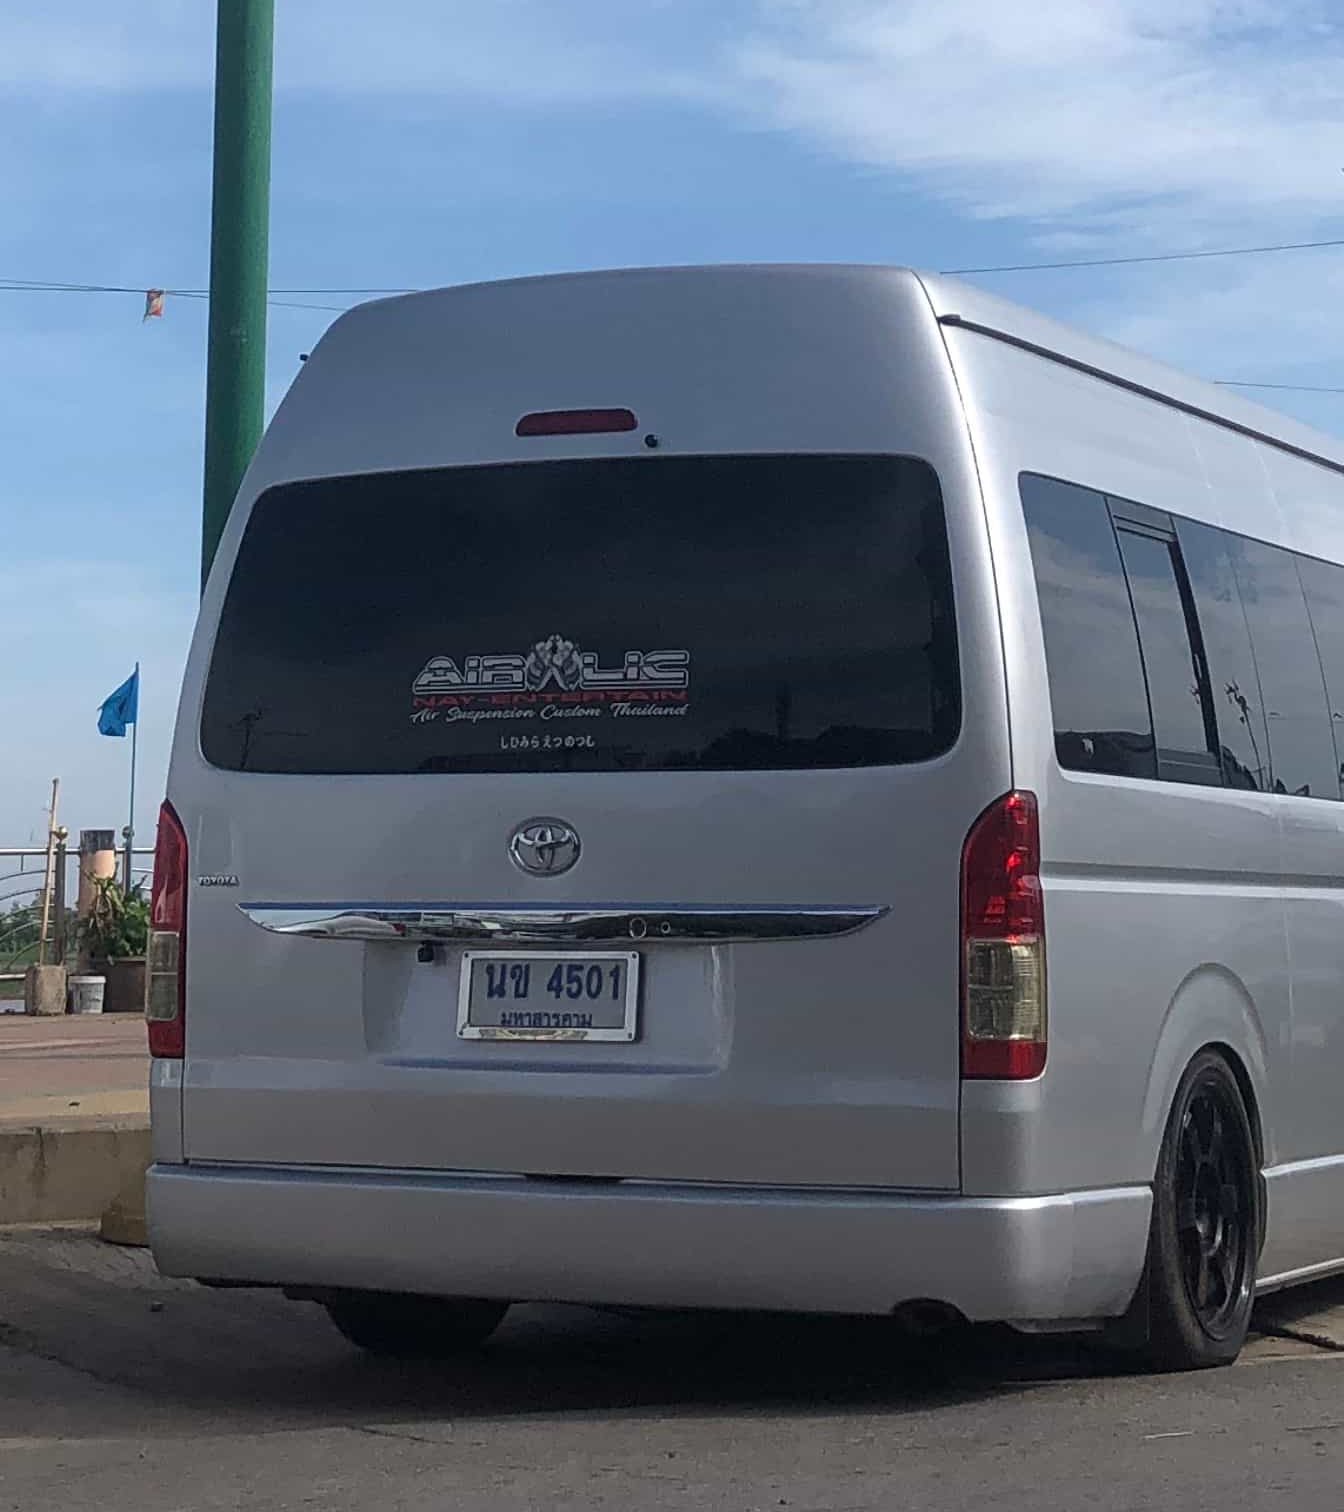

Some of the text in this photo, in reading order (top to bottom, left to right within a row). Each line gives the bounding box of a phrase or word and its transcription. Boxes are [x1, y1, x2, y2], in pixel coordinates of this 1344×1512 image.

[409, 702, 690, 725] Air Suspension Custom Thailand
[199, 875, 240, 887] TOYOTA
[546, 964, 622, 1000] 4501
[500, 1008, 594, 1027] มหาสารคาม
